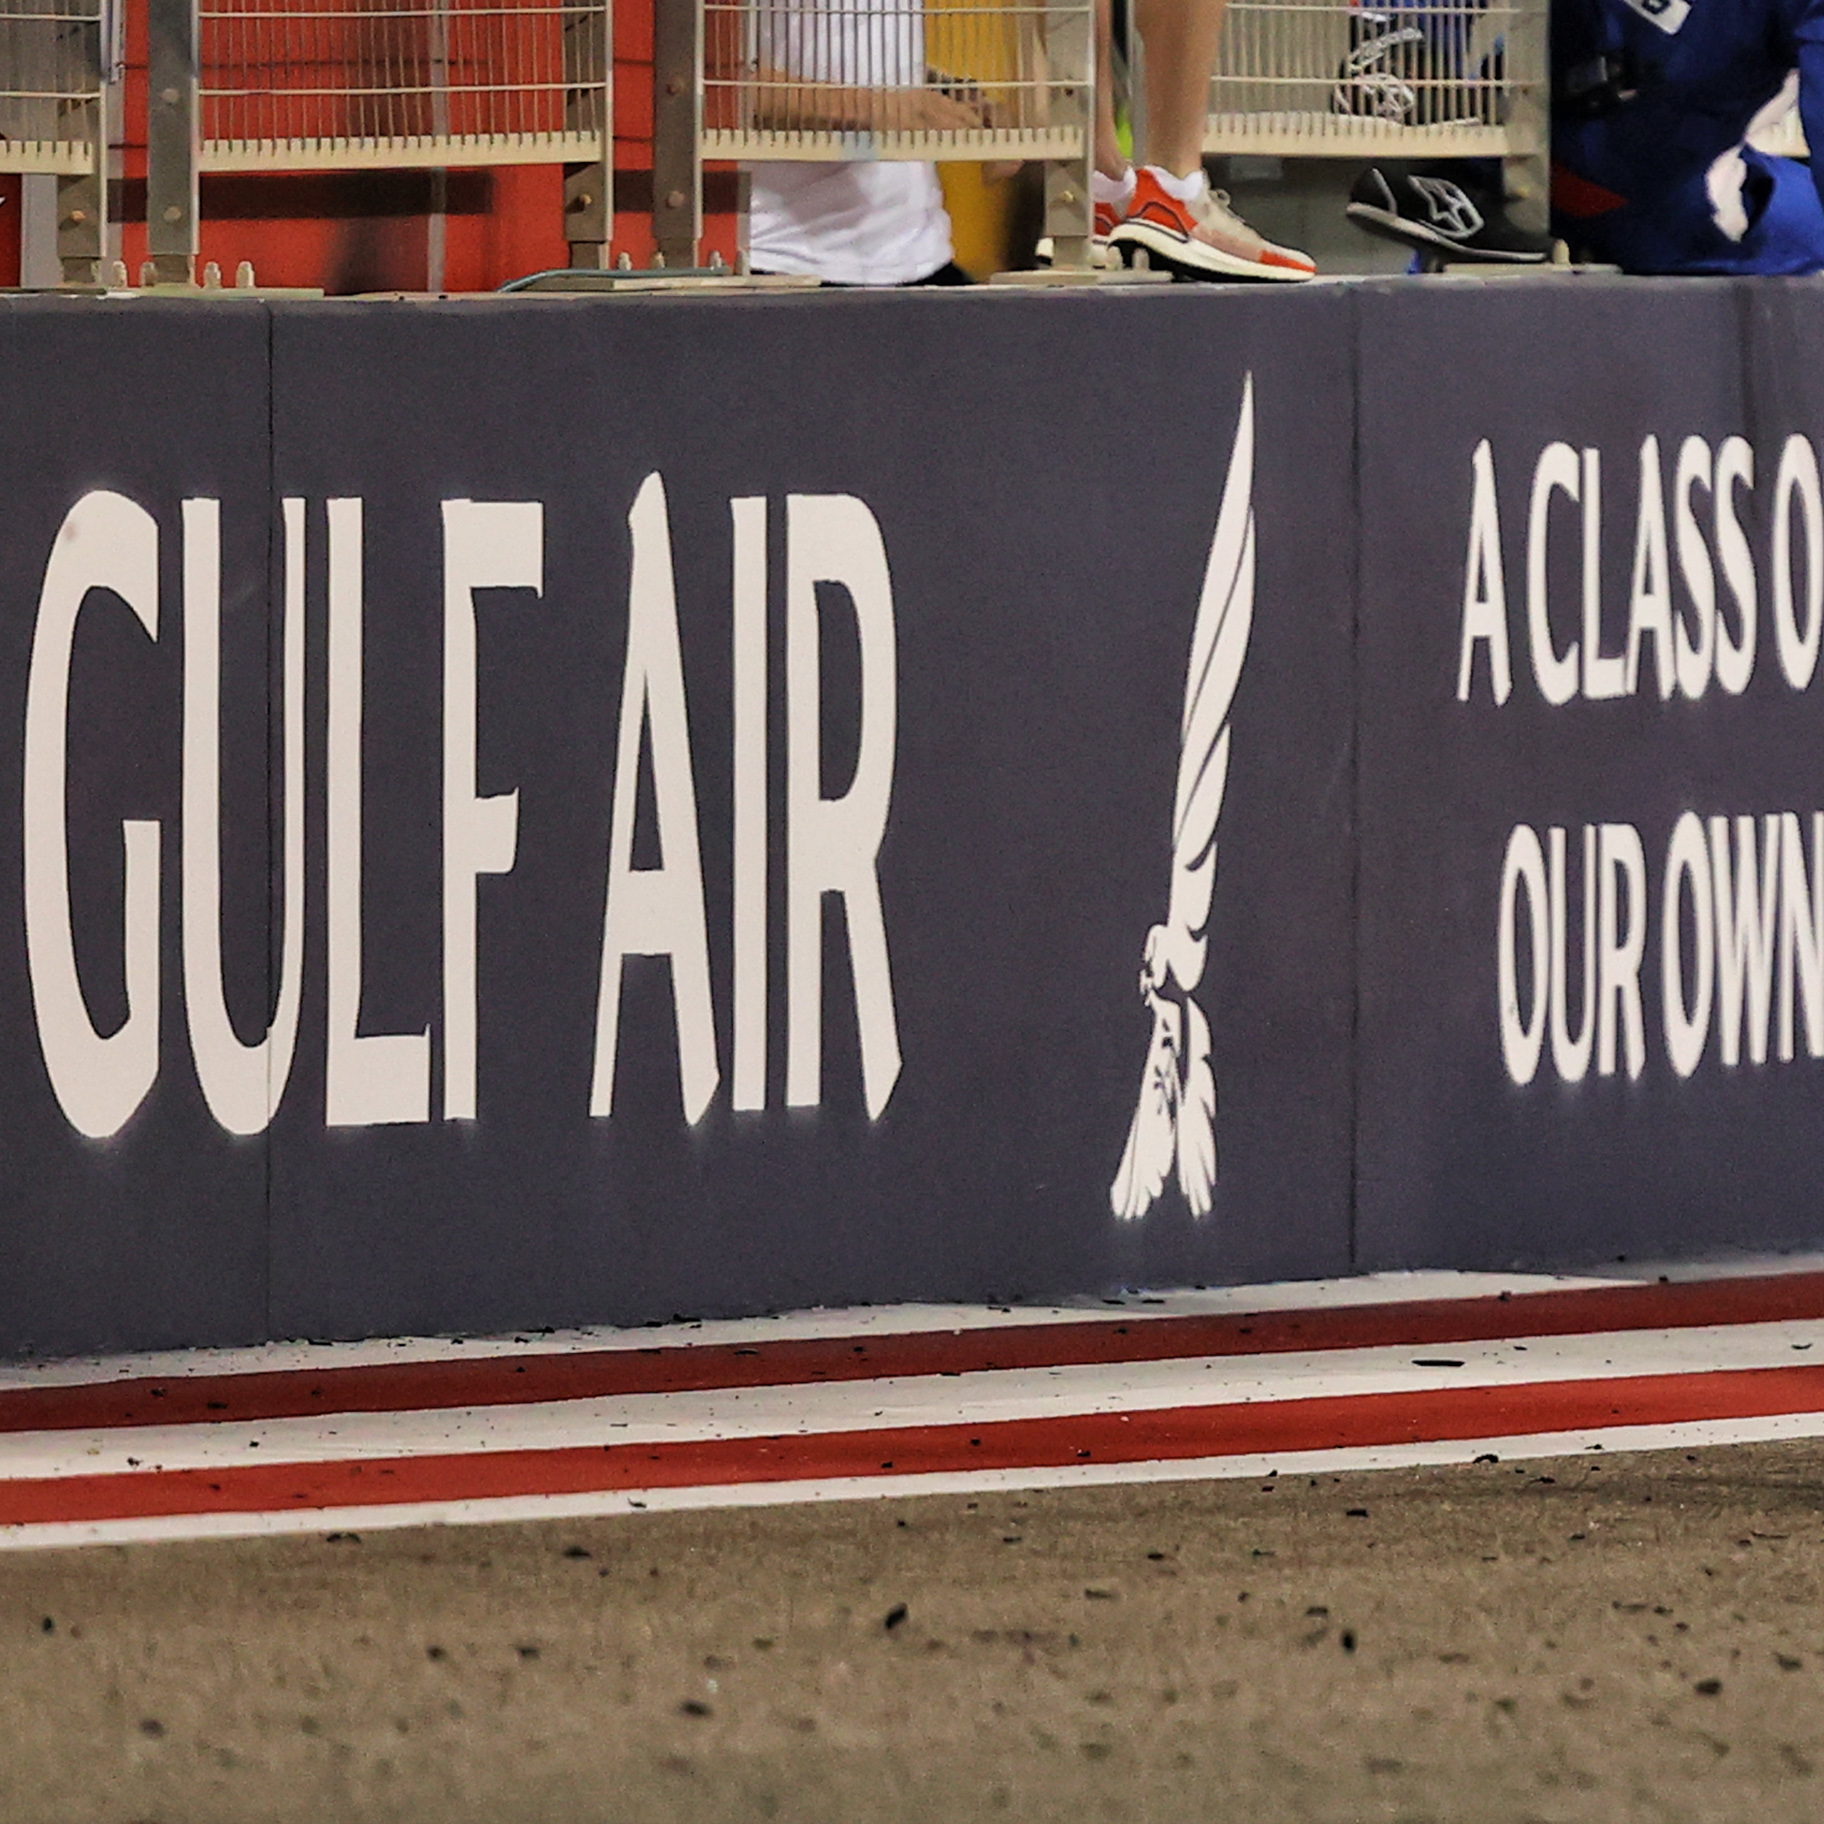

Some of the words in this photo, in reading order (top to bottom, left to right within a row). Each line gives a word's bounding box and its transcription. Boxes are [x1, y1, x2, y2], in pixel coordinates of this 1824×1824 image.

[1457, 438, 1513, 706] A
[1527, 433, 1758, 706] CLASS
[22, 488, 544, 1140] GULF
[588, 470, 904, 1127] AIR
[1497, 822, 1647, 1086] OUR
